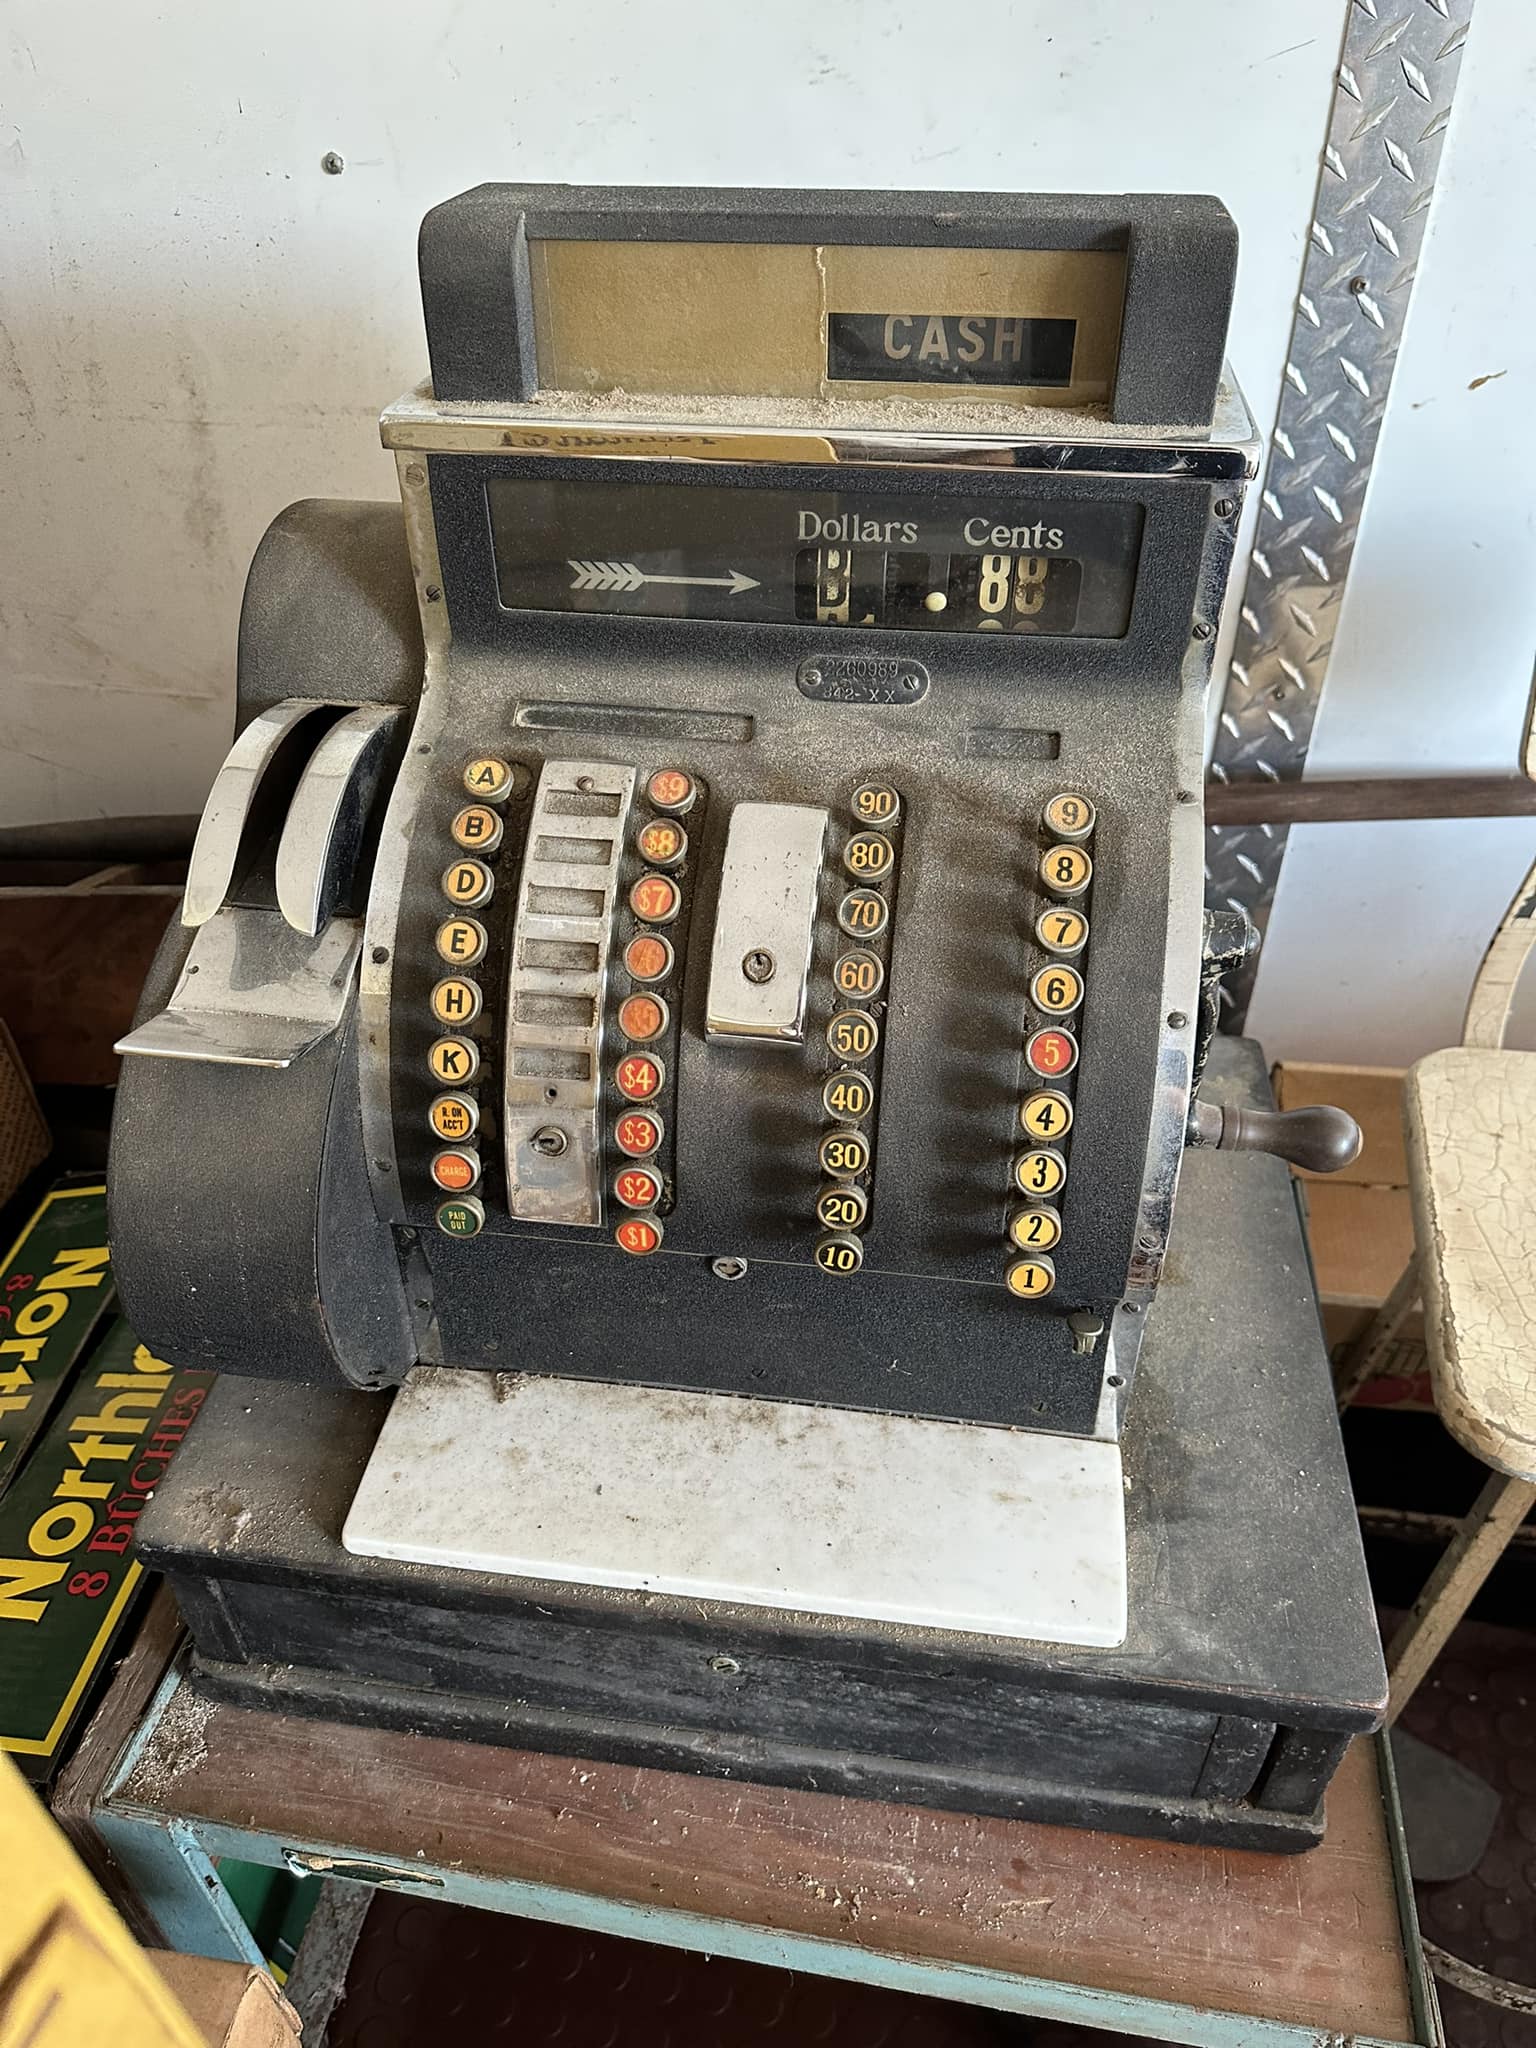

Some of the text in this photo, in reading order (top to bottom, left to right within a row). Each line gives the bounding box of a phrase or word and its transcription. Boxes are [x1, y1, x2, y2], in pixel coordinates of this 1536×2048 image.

[883, 315, 1024, 363] CASH
[797, 510, 1065, 550] Dollars Cents
[475, 766, 497, 787] A
[657, 775, 686, 800] $9
[859, 791, 892, 815] 90
[1061, 800, 1080, 826] 9
[464, 815, 484, 838] B
[850, 842, 884, 868] 80
[456, 869, 476, 893] D
[1055, 855, 1074, 883] 8
[638, 886, 668, 913] $7
[850, 898, 880, 929] 70
[450, 928, 467, 955] E
[1055, 916, 1073, 944] 7
[840, 962, 874, 991] 60
[445, 988, 464, 1014] H
[1046, 977, 1065, 1006] 6
[836, 1024, 870, 1053] 50
[442, 1049, 461, 1075] K
[1043, 1039, 1060, 1067] 5
[624, 1063, 653, 1092] $4
[830, 1083, 864, 1113] 40
[1035, 1103, 1054, 1131] 4
[623, 1121, 651, 1147] $3
[827, 1141, 861, 1170] 30
[440, 1165, 468, 1177] CHARGE
[1031, 1157, 1048, 1188] 3
[624, 1176, 652, 1202] $2
[448, 1210, 466, 1220] PAID
[825, 1197, 859, 1224] 20
[450, 1220, 466, 1230] OUT
[627, 1228, 648, 1248] $1
[1028, 1215, 1043, 1243] 2
[823, 1245, 855, 1270] 10
[1023, 1267, 1034, 1289] 1
[0, 1343, 175, 1623] Northl
[67, 1387, 208, 1598] 8 BÛCHES
